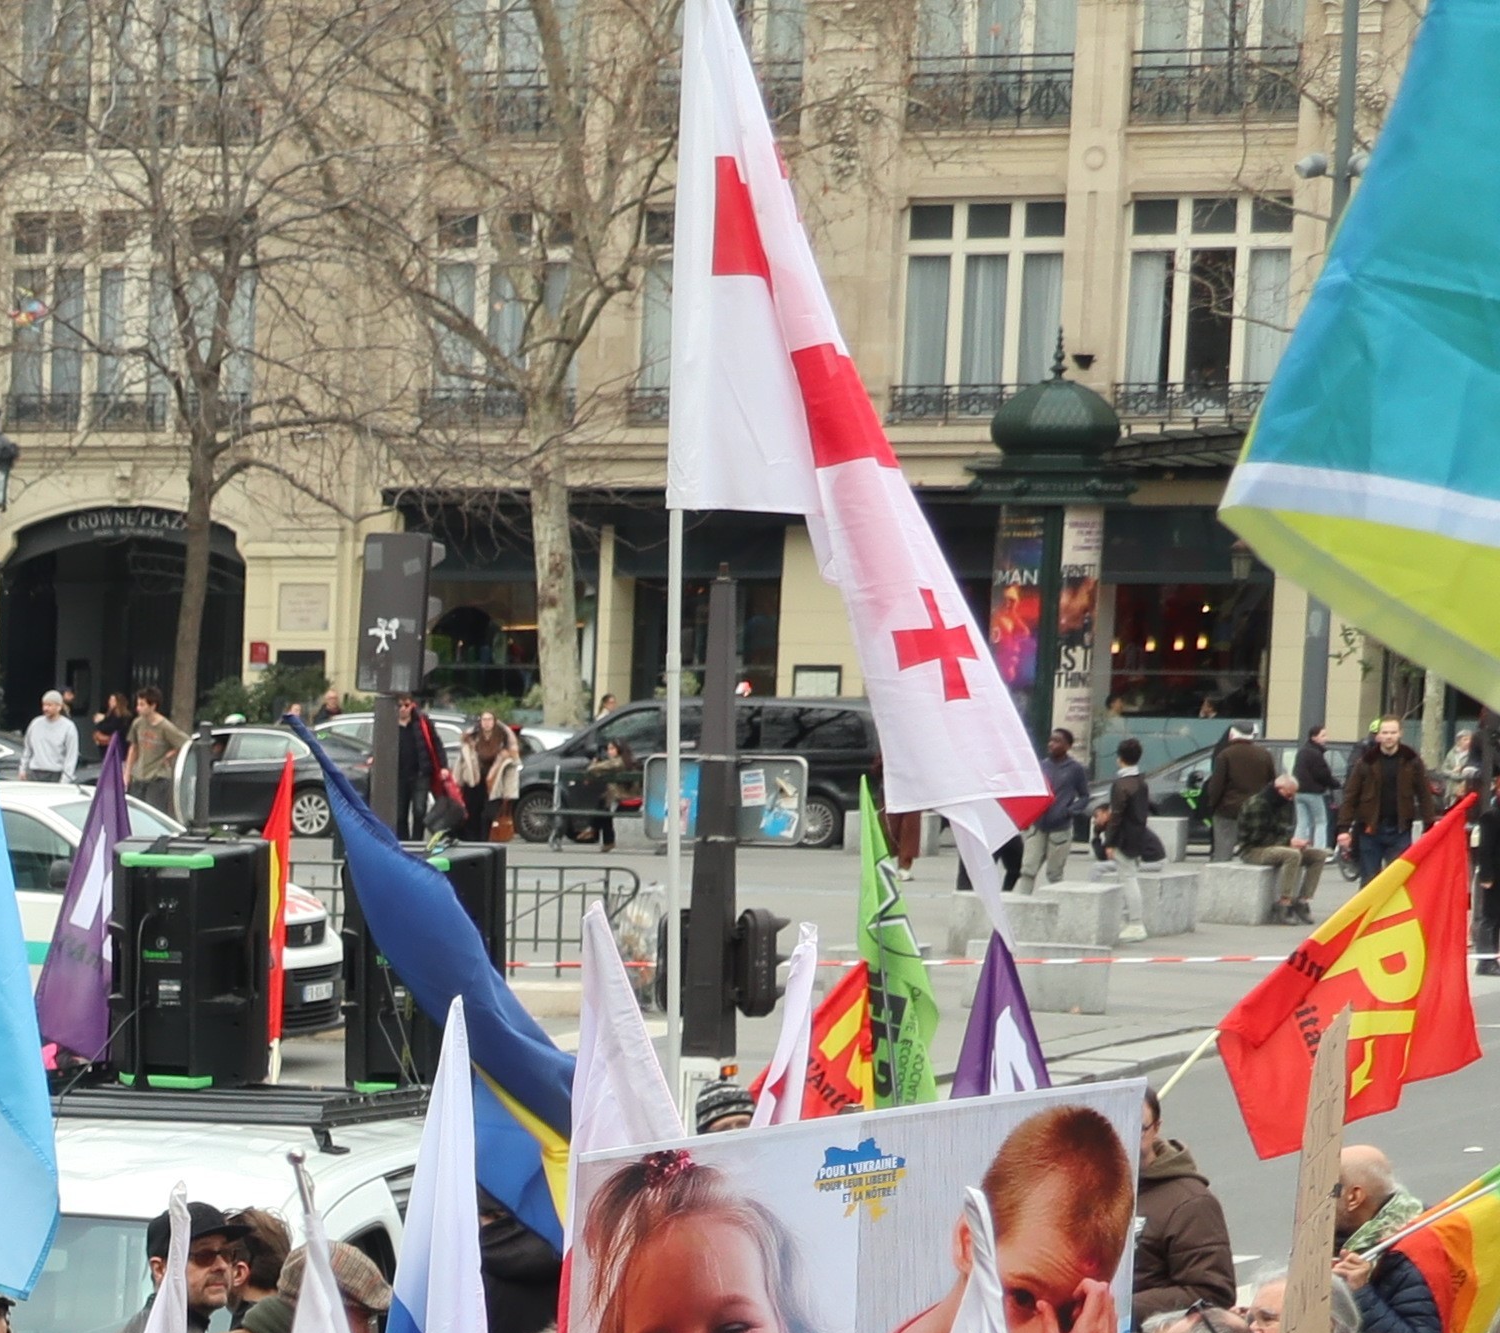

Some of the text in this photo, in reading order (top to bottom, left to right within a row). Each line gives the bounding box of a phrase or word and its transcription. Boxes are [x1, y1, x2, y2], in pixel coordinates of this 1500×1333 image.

[67, 510, 135, 532] CROWNE
[819, 1164, 846, 1180] POUR
[819, 1168, 897, 1193] POUR LEUR LIBERTÉ
[842, 1192, 851, 1203] ET
[853, 1191, 864, 1203] LA
[865, 1186, 892, 1200] NÔTRE
